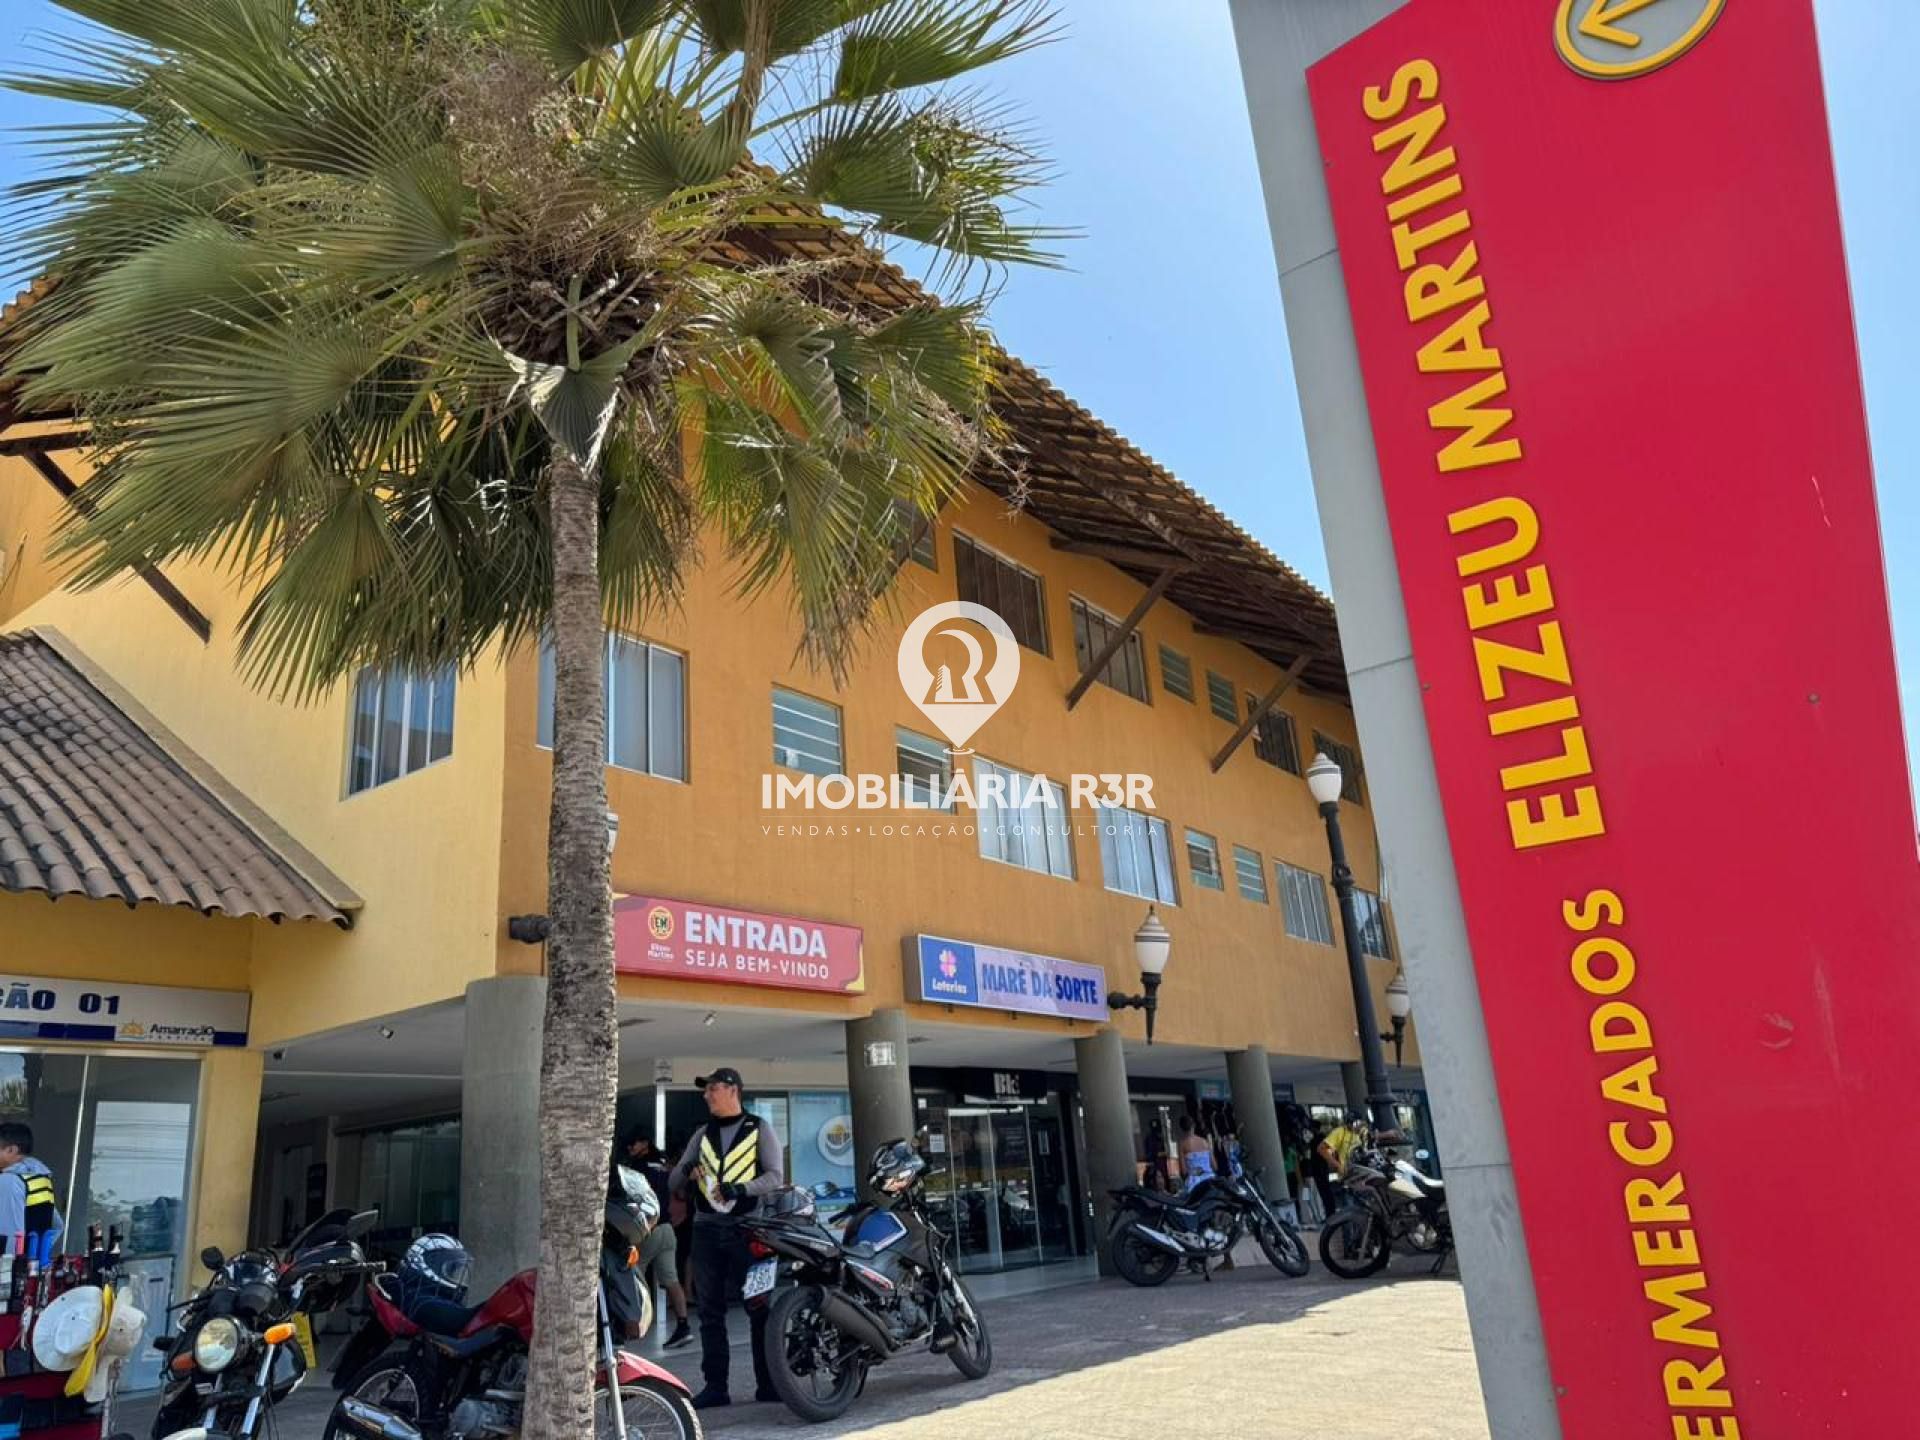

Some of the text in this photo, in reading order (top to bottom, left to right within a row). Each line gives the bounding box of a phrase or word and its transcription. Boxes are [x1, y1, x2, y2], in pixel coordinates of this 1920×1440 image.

[1363, 59, 1522, 472] MARTINS
[1448, 497, 1605, 849] ELIZEU
[684, 911, 828, 959] ENTRADA
[684, 948, 830, 980] SEJA BEM-VINDO
[932, 977, 967, 994] Loterias
[982, 961, 1098, 1005] MARÉ DA SORTE
[78, 992, 120, 1015] 01
